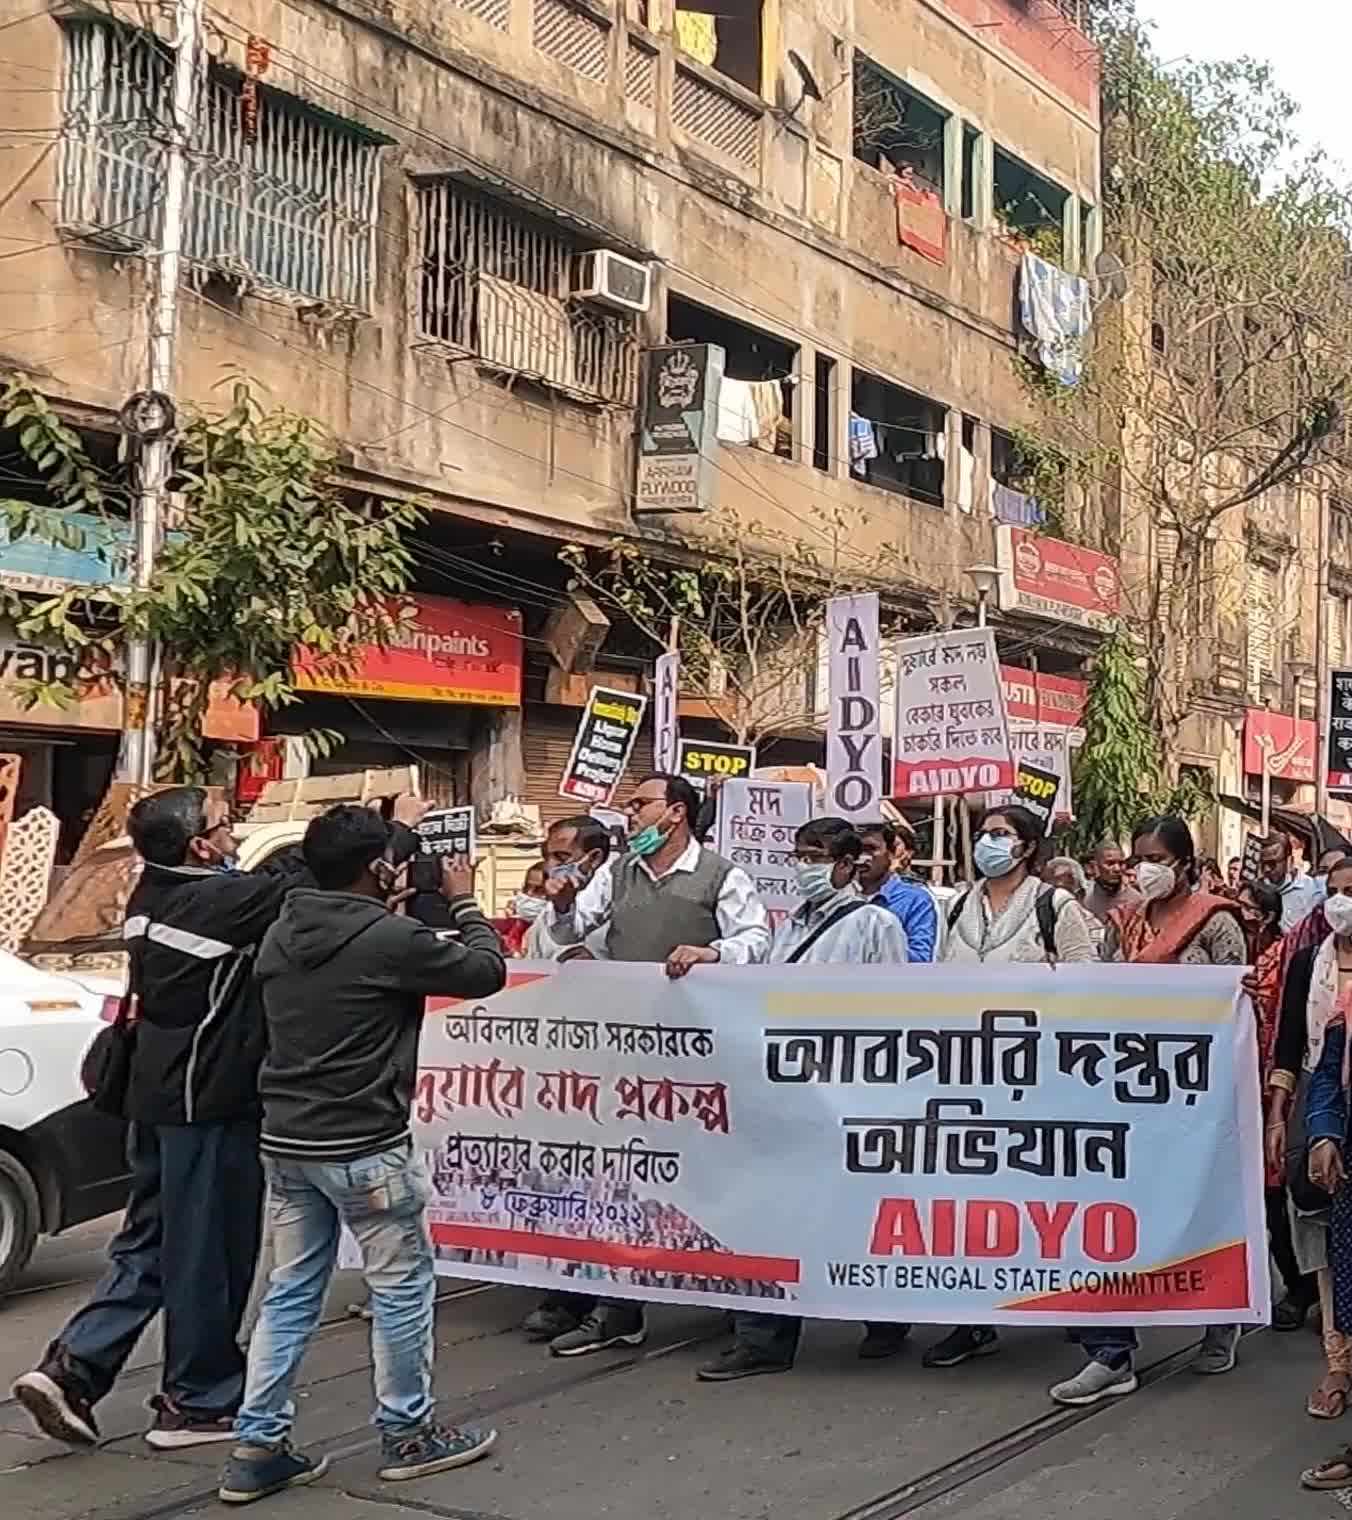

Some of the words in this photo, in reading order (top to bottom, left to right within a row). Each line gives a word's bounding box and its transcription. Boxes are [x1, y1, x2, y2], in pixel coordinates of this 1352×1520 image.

[928, 674, 967, 695] সকল
[834, 617, 876, 812] AIDYO
[906, 703, 945, 726] বেকার
[685, 751, 748, 776] STOP
[909, 764, 1001, 795] AIDYO
[747, 787, 782, 816] মদ
[446, 1006, 539, 1047] অবিলম্বে
[546, 1017, 600, 1050] রাজ্য
[605, 1022, 714, 1057] সরকারকে
[764, 1009, 1042, 1101] আবগারি
[1054, 1031, 1213, 1105] দপ্তর
[416, 1058, 525, 1123] দুয়ারে
[536, 1070, 604, 1126] মদ
[614, 1075, 730, 1133] প্রকল্প
[448, 1132, 532, 1173] প্রত্যাহার
[538, 1141, 597, 1177] করার
[602, 1137, 681, 1184] দাবিতে
[842, 1098, 1130, 1179] অভিযান
[504, 1190, 588, 1221] ফেব্রুয়ারি
[594, 1200, 643, 1227] ২০২২
[869, 1197, 1138, 1263] AIDYO
[828, 1262, 888, 1288] WEST
[895, 1264, 984, 1291] BENGAL
[993, 1267, 1061, 1293] STATE
[1069, 1269, 1205, 1296] COMMITTEE
